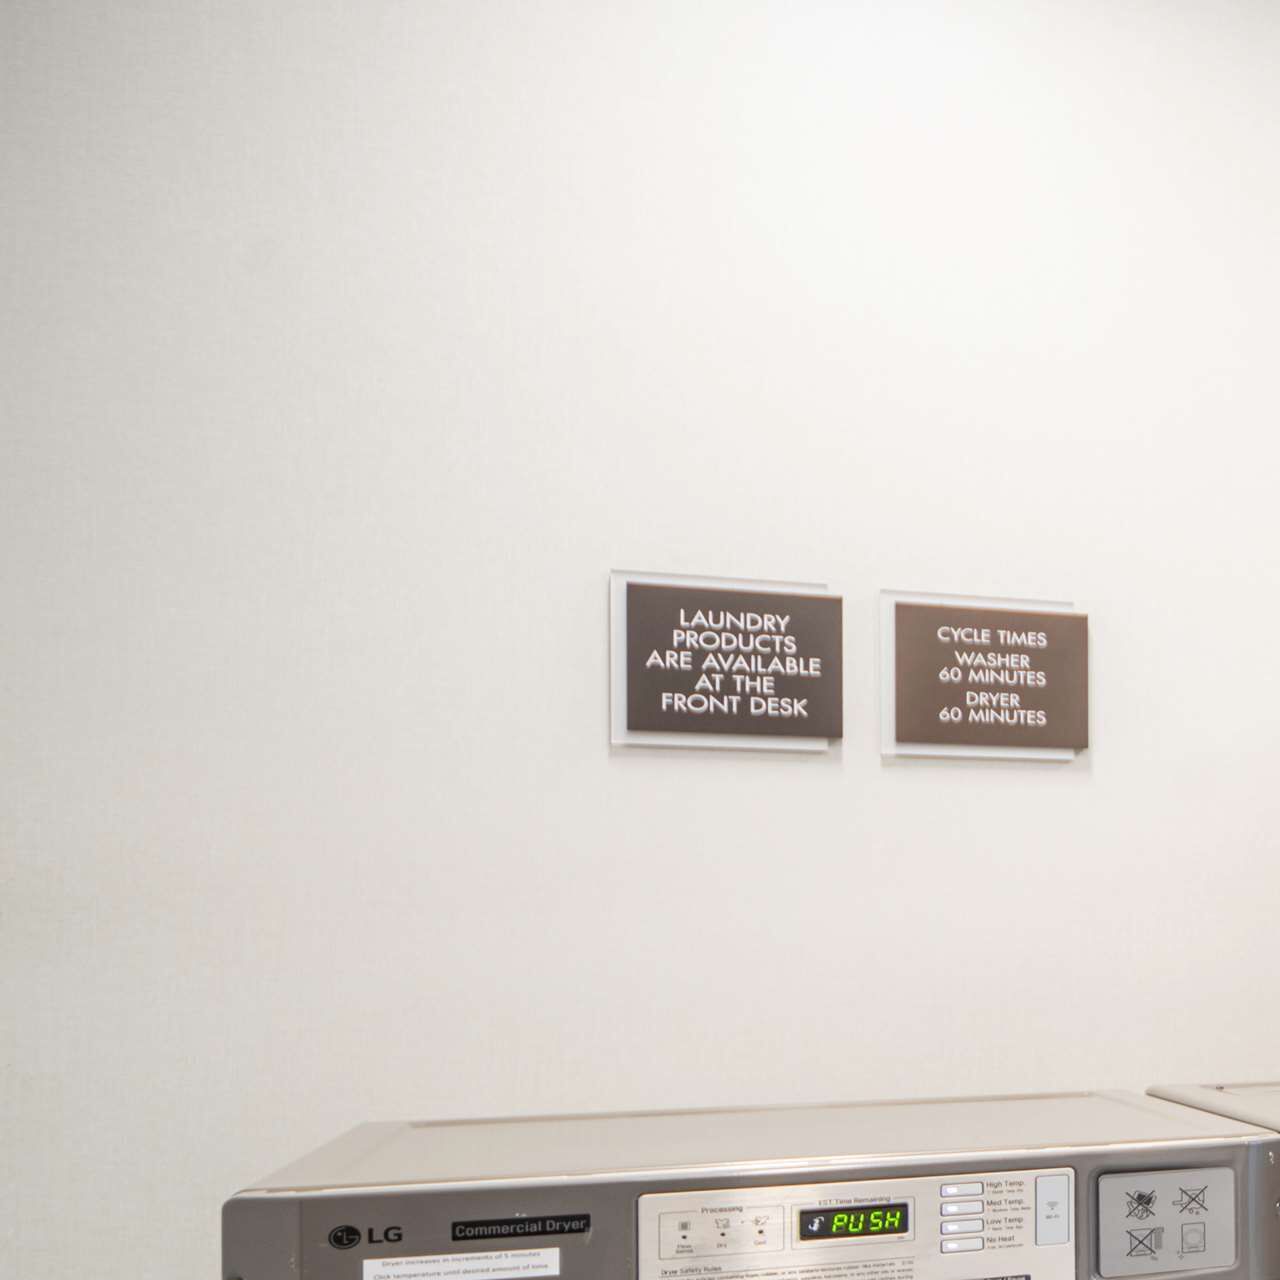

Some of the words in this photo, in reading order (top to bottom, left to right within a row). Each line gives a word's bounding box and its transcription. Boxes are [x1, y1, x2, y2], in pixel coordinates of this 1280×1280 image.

[680, 608, 790, 633] LAUNDRY
[673, 629, 797, 654] PRODUCTS
[937, 626, 991, 645] CYCLE
[997, 629, 1048, 648] TIMES
[645, 649, 692, 671] ARE
[702, 653, 822, 677] AVAILABLE
[954, 650, 1030, 669] WASHER
[694, 673, 724, 692] AT
[732, 675, 775, 695] THE
[939, 666, 962, 683] 60
[968, 668, 1047, 688] MINUTES
[662, 692, 740, 715] FRONT
[750, 696, 808, 718] DESK
[966, 691, 1020, 708] DRYER
[939, 706, 962, 723] 60
[968, 708, 1047, 727] MINUTES
[986, 1181, 1003, 1189] High
[701, 1206, 743, 1214] Processing
[854, 1196, 891, 1204] Remaining
[368, 1226, 403, 1244] LG
[455, 1222, 542, 1238] Commercial
[546, 1218, 586, 1235] Dryer
[832, 1211, 900, 1233] PUSH
[986, 1217, 1001, 1225] Low
[381, 1260, 403, 1269] Dryer
[405, 1257, 440, 1266] increases
[451, 1255, 493, 1264] increments
[510, 1251, 541, 1259] minutes
[373, 1272, 391, 1280] Click
[393, 1270, 441, 1280] temperature
[443, 1268, 460, 1276] until
[462, 1266, 490, 1275] desired
[491, 1264, 520, 1273] amount
[680, 1267, 701, 1275] Safety
